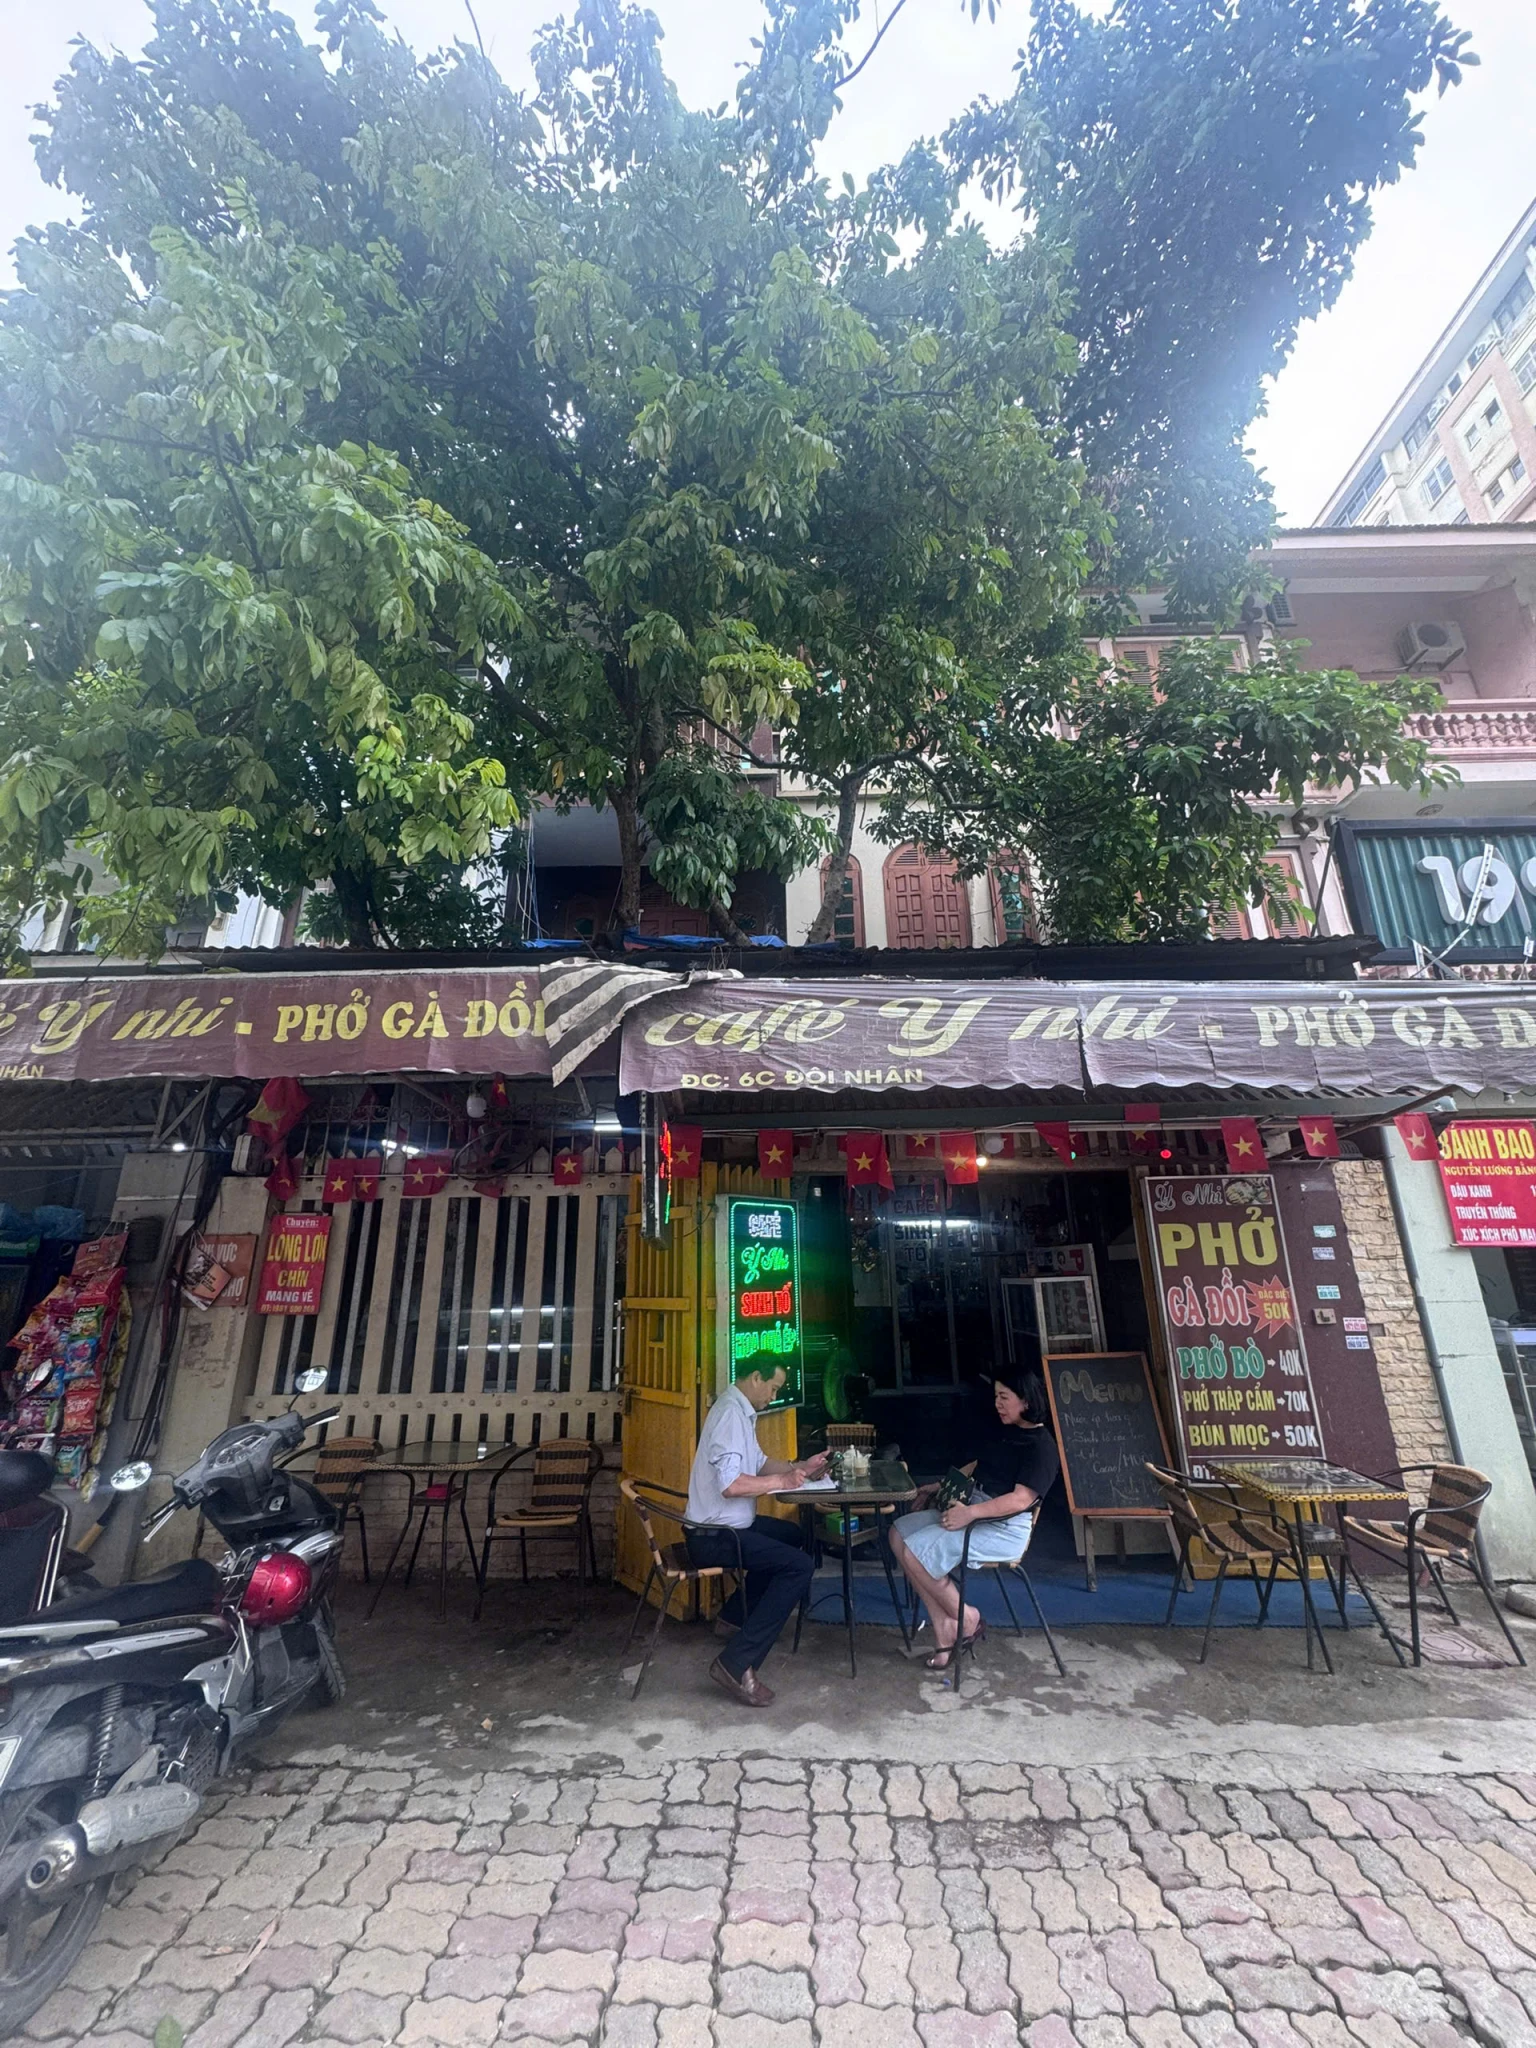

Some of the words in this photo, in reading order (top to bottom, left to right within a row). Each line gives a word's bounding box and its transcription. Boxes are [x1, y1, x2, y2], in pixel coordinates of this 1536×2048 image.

[31, 988, 114, 1055] Ý
[111, 997, 234, 1040] nhi
[273, 988, 372, 1042] PHỞ
[382, 990, 449, 1039] GÀ
[644, 999, 859, 1052] café
[1008, 996, 1178, 1041] nhi
[1251, 990, 1375, 1047] PHỞ
[1392, 996, 1484, 1048] GÀ
[681, 1073, 729, 1087] ĐC:
[739, 1070, 776, 1087] 6C
[784, 1067, 834, 1088] ĐỘI
[844, 1065, 923, 1084] NHÂN
[1492, 1128, 1535, 1159] BAO
[1182, 1183, 1223, 1205] Nhi
[1468, 1185, 1492, 1197] XANH
[286, 1217, 319, 1228] Chuyên:
[1487, 1202, 1517, 1219] THỐNG
[267, 1228, 302, 1262] LÒNG
[1158, 1207, 1278, 1266] PHỞ
[1461, 1226, 1479, 1241] XÚC
[1480, 1226, 1499, 1241] XÍCH
[278, 1267, 309, 1287] CHÍN
[266, 1291, 299, 1302] MANG
[1168, 1275, 1205, 1327] GÀ
[1204, 1267, 1250, 1326] ĐỒI
[1263, 1302, 1291, 1319] 50K
[1177, 1334, 1227, 1379] PHỞ
[1230, 1337, 1265, 1379] BÒ
[1279, 1349, 1304, 1376] 40K
[1183, 1383, 1210, 1411] PHỞ
[1211, 1386, 1243, 1416] THẬP
[1246, 1382, 1276, 1411] CẨM
[1284, 1390, 1309, 1411] 70K
[1188, 1420, 1225, 1446] BÚN
[1229, 1424, 1270, 1450] MỌC
[1284, 1425, 1319, 1447] 50K
